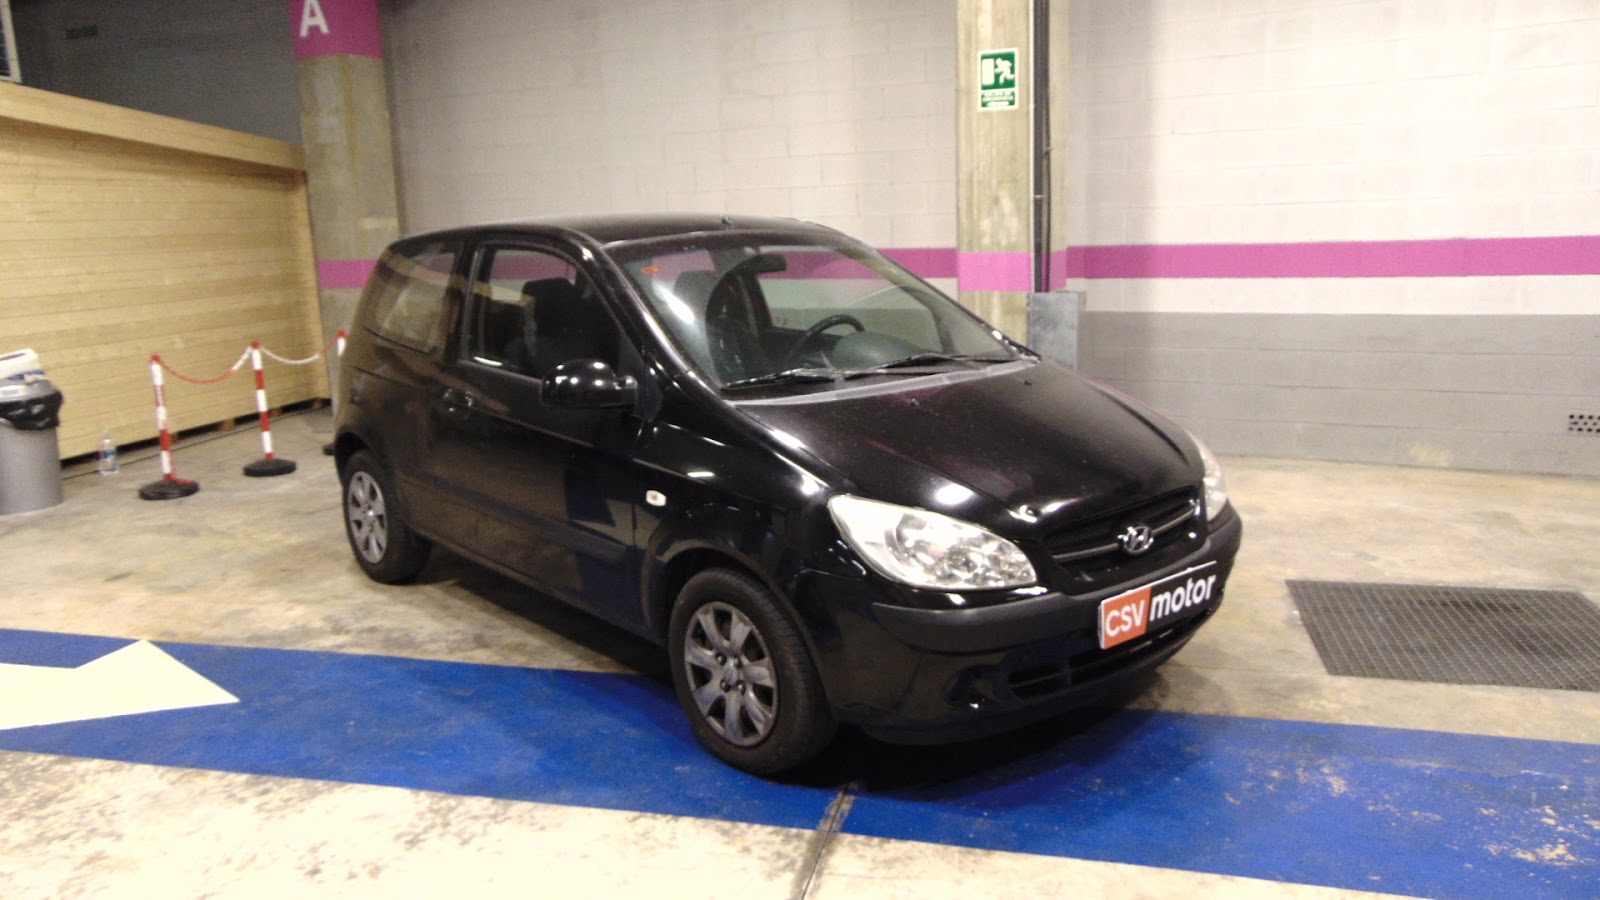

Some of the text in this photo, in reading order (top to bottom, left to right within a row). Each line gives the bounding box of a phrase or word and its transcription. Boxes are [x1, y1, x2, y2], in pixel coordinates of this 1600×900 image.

[300, 0, 330, 37] A
[1105, 574, 1217, 637] CSV motor
